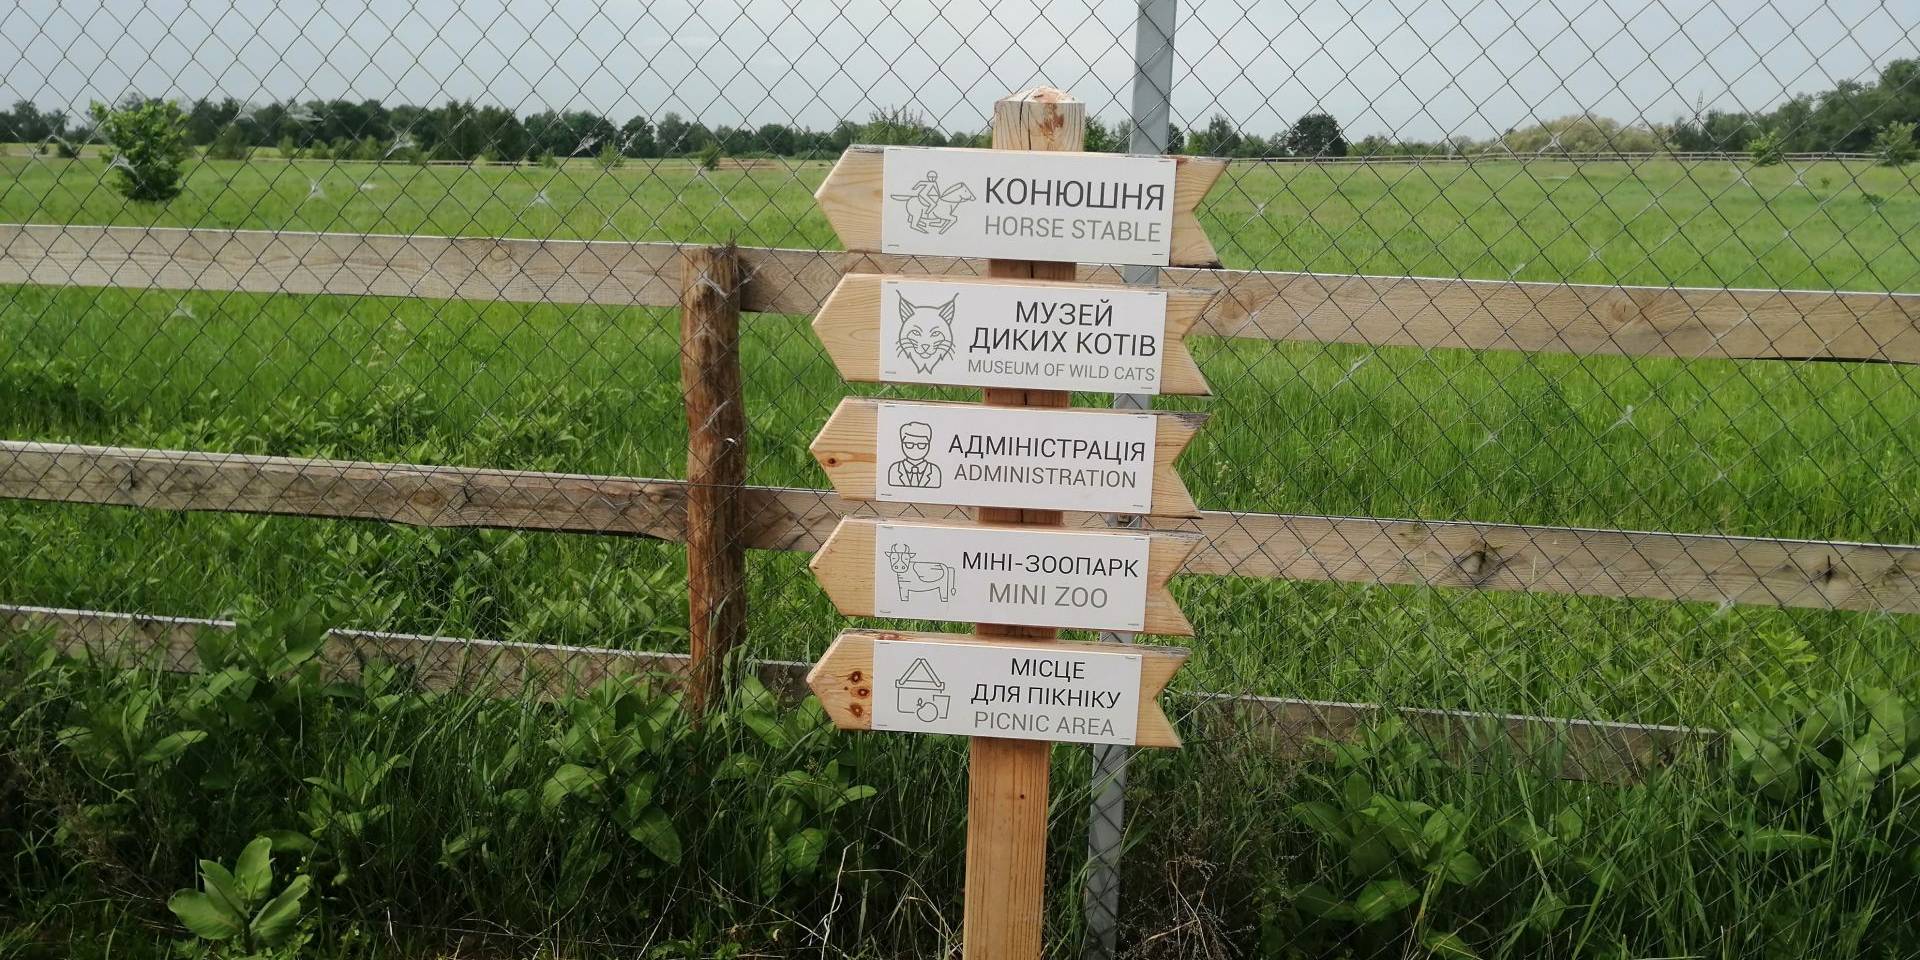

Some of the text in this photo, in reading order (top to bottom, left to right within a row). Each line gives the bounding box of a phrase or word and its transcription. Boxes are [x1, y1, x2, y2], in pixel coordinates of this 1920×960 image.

[985, 177, 1164, 211] КОНЮШНЯ
[985, 216, 1161, 242] HORSE STABLE
[1016, 299, 1112, 327] МУЗЕЙ
[969, 327, 1156, 357] ДИКИХ КОТІВ
[968, 360, 1155, 381] MUSEUM OF WILD CATS
[949, 434, 1145, 463] АДМІНІСТРАЦІЯ
[954, 464, 1136, 488] ADMINISTRATION
[962, 551, 1139, 578] МІНІ-ЗООПАРК
[989, 582, 1108, 608] MINI ZOO
[1011, 658, 1085, 682] МІСЦЕ
[971, 683, 1121, 709] ДЛЯ ПІКНІКУ
[974, 711, 1115, 736] PICNIC AREA
